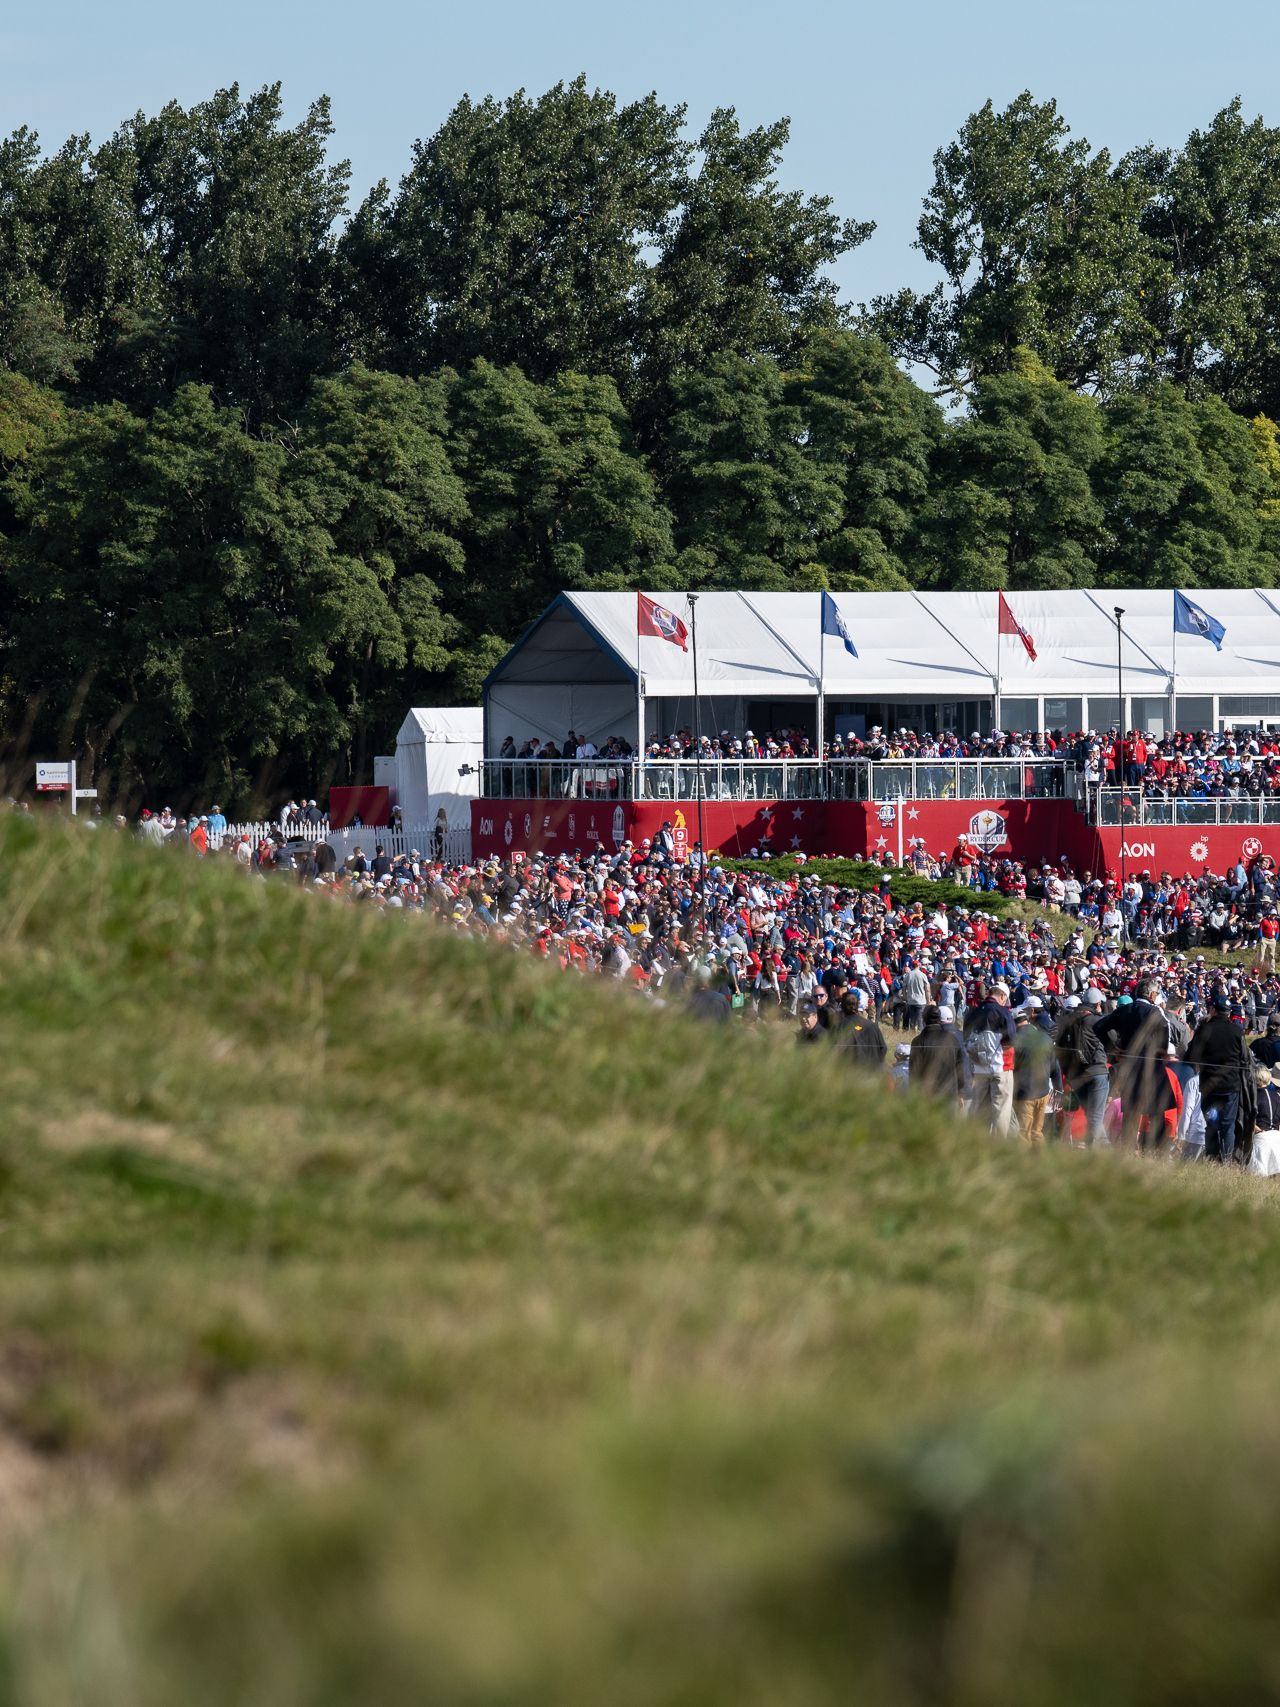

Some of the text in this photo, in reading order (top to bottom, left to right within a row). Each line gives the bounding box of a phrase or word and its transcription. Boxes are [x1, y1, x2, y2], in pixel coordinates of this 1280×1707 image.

[676, 831, 685, 841] 9
[991, 835, 1006, 843] CUP
[1200, 834, 1209, 843] bp
[1118, 842, 1155, 858] AON
[515, 853, 523, 863] 9
